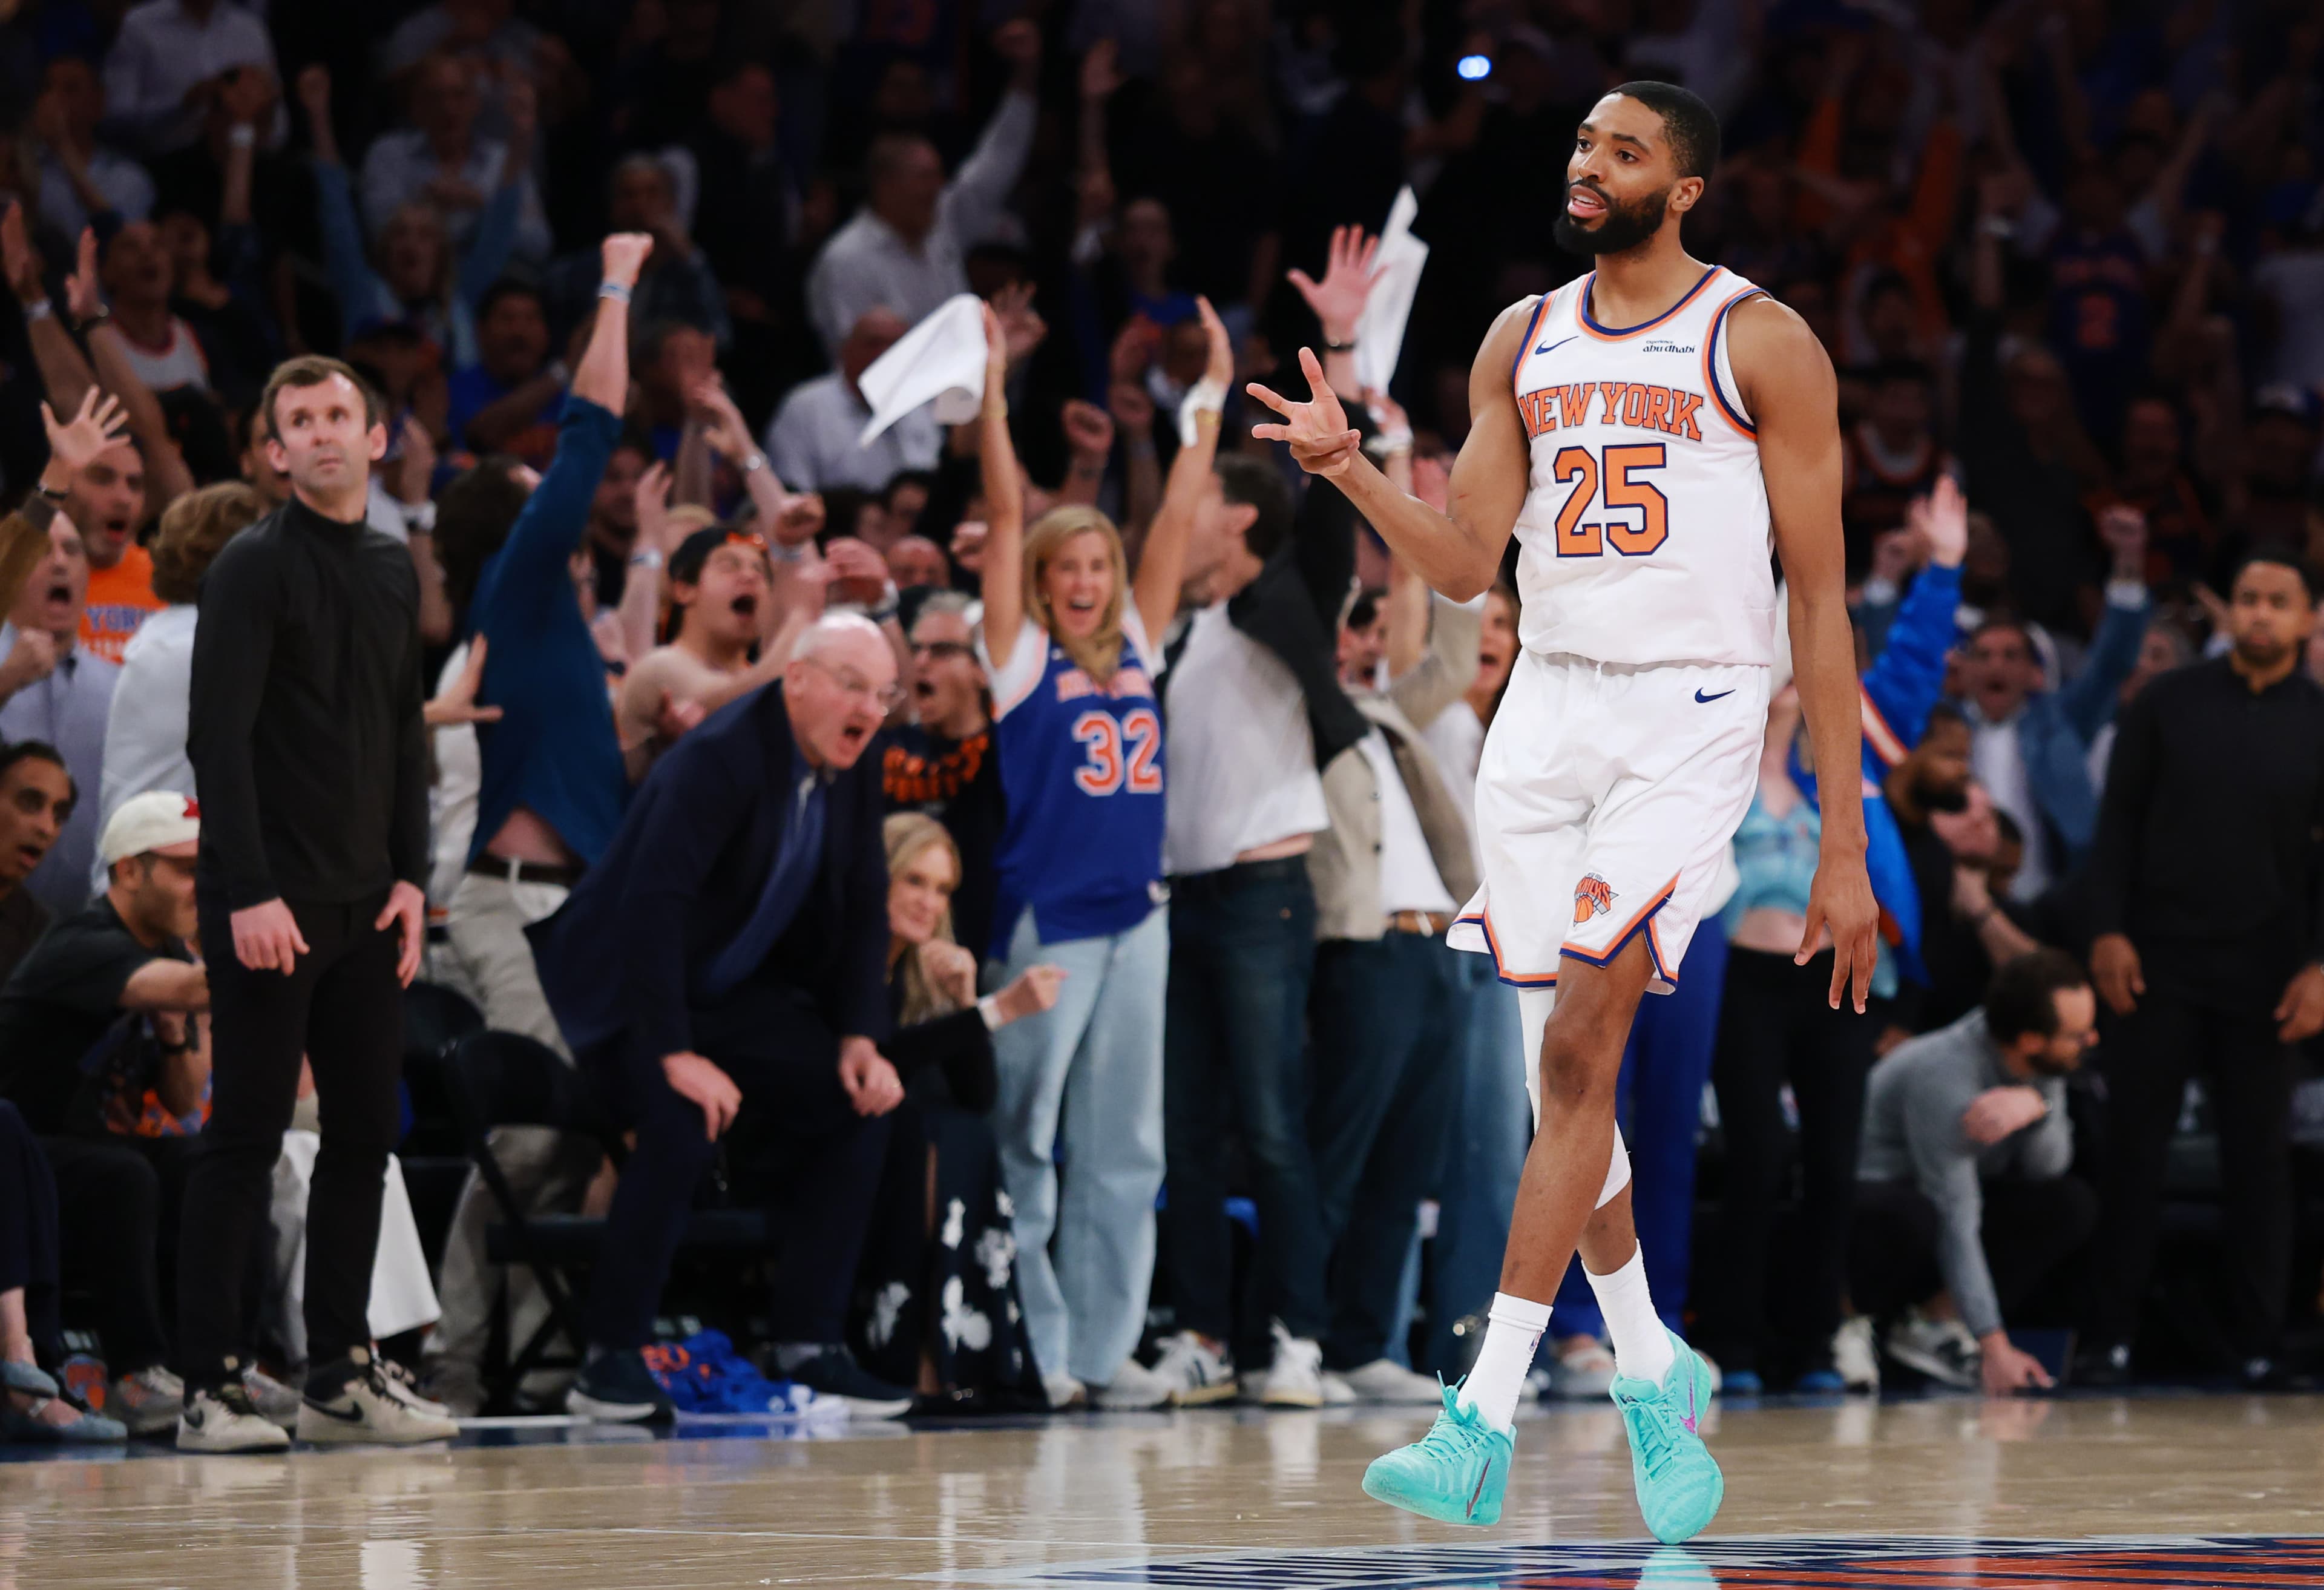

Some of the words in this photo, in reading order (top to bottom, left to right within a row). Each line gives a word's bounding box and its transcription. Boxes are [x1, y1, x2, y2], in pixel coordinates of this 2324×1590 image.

[1664, 344, 1696, 353] dhabi
[1518, 382, 1597, 441] NEW
[1599, 381, 1704, 442] YORK
[1553, 442, 1669, 557] 25
[1073, 709, 1163, 796] 32
